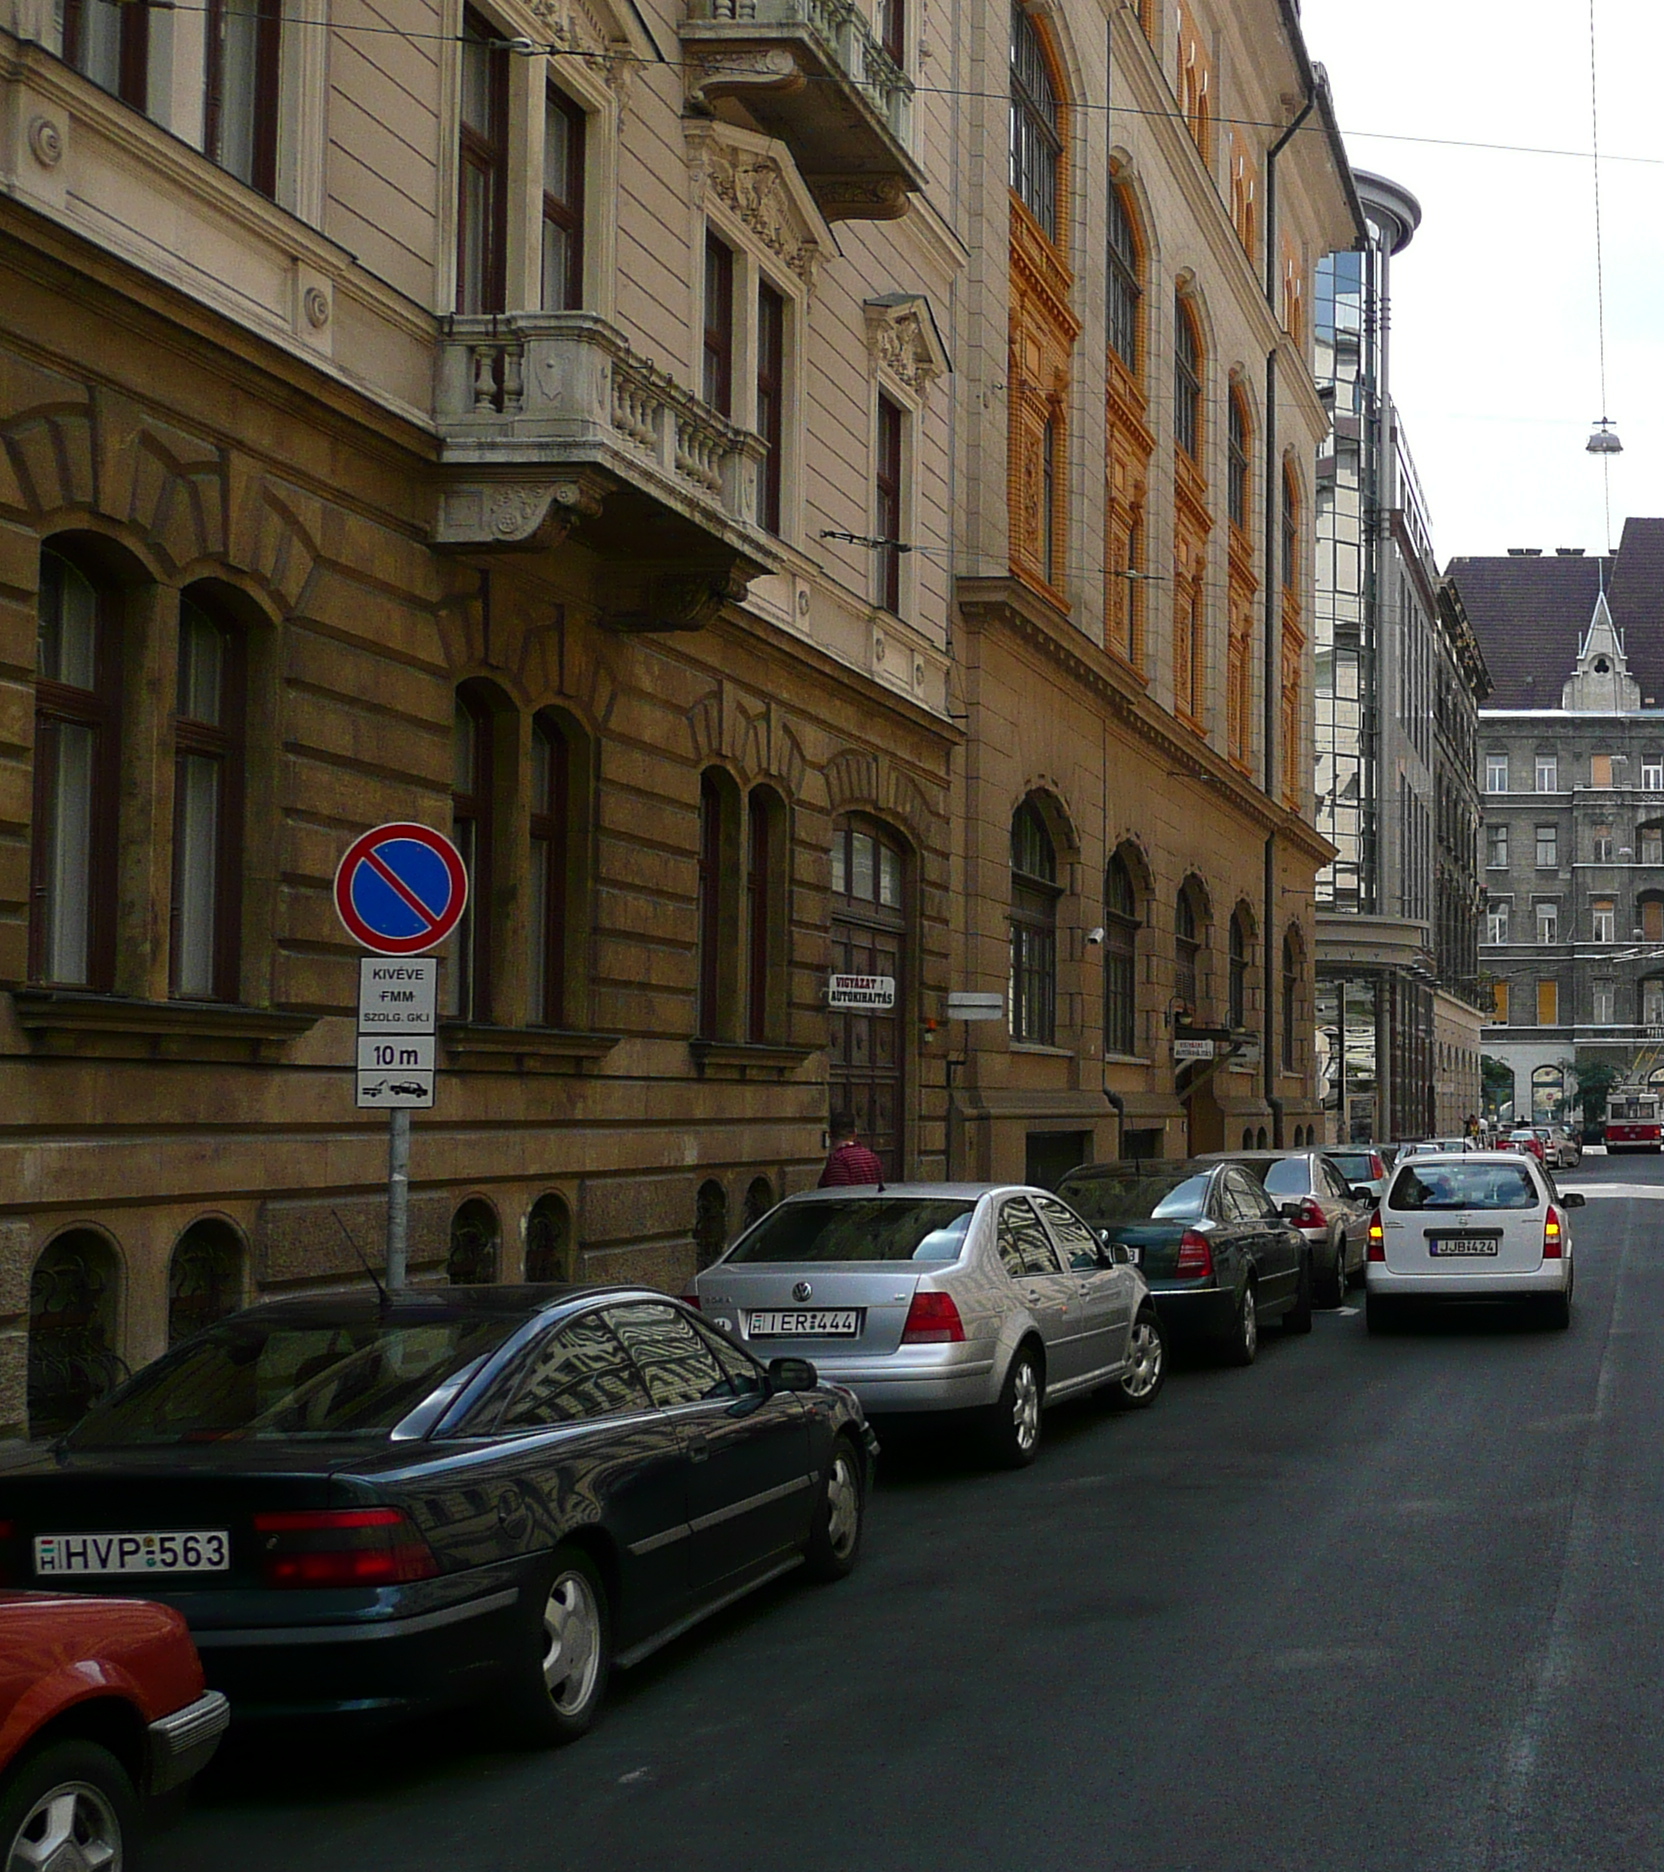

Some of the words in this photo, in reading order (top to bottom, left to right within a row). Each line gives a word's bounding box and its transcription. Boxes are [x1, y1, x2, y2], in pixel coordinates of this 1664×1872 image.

[372, 966, 425, 980] KIVÉVE
[363, 1012, 405, 1023] SZOLG.
[373, 1045, 394, 1066] 10
[399, 1049, 419, 1066] m
